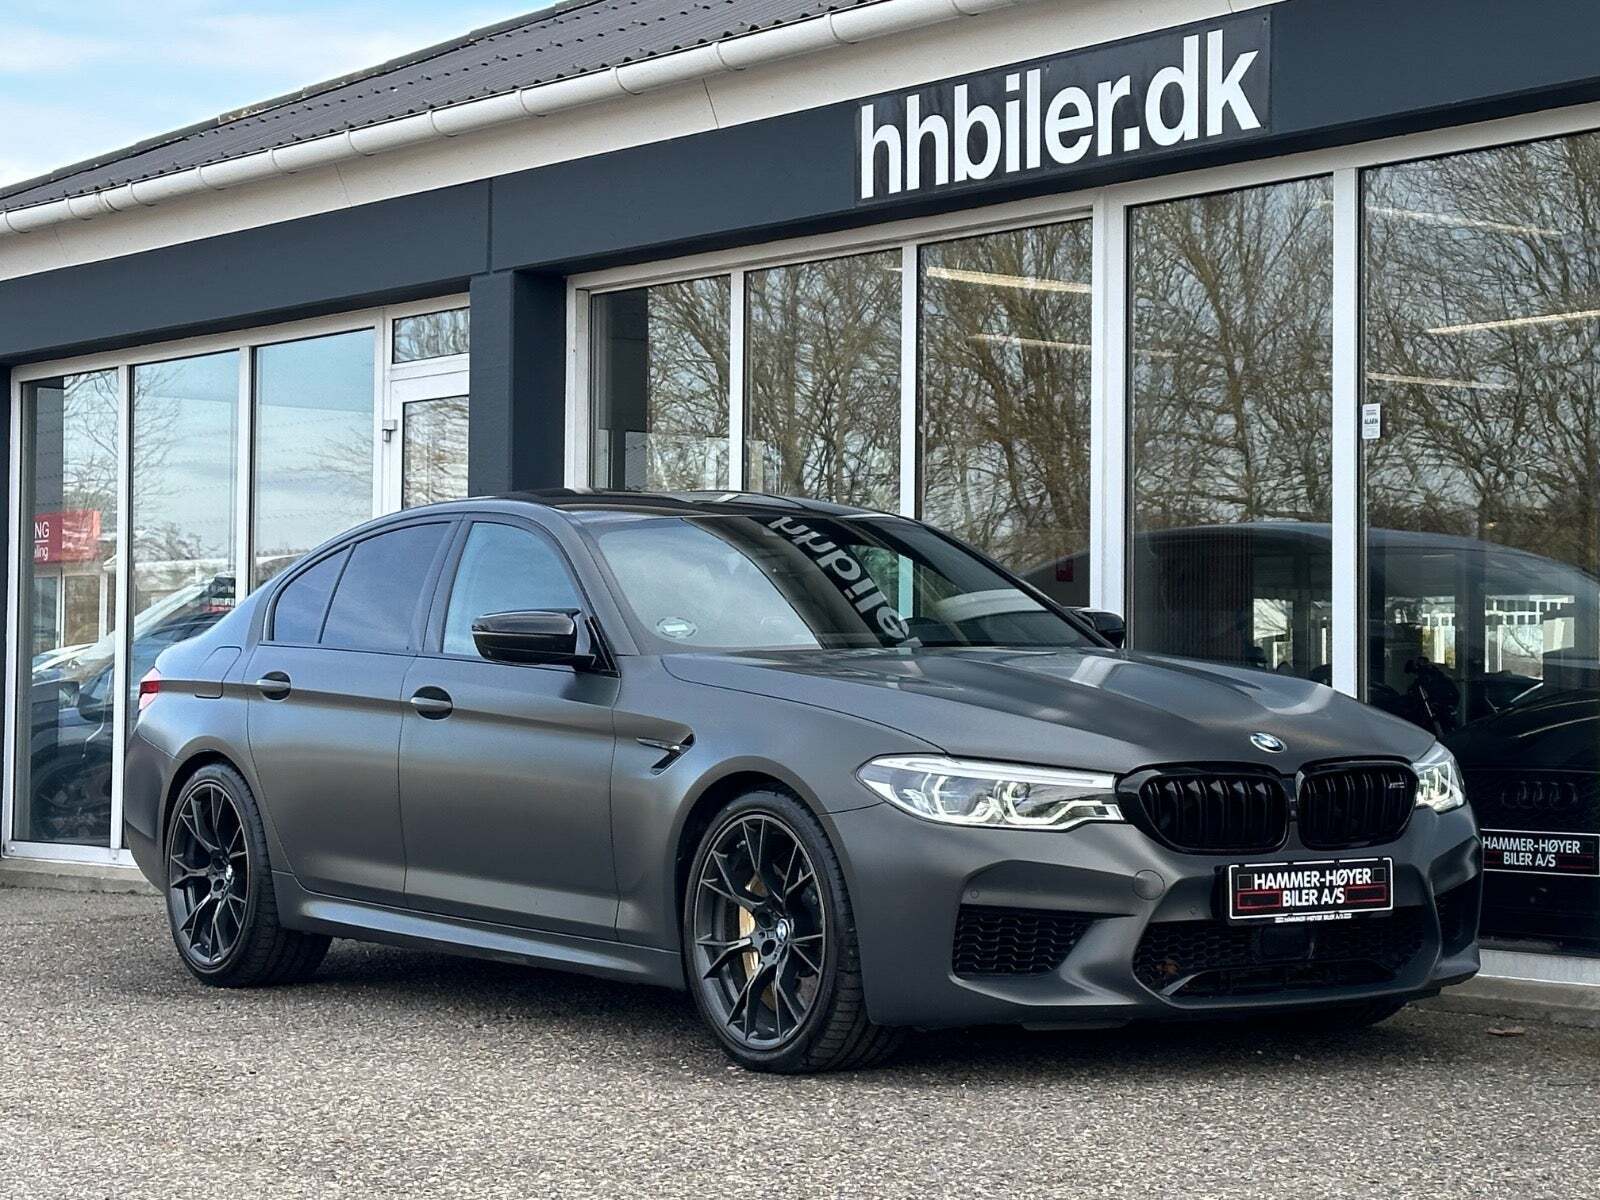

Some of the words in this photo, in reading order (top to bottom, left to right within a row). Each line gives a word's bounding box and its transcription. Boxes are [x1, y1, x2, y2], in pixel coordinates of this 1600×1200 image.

[861, 29, 1262, 199] hhbiler.dk
[1482, 835, 1581, 854] HAMMER-HØYER
[1503, 851, 1533, 866] BILER
[1535, 853, 1556, 867] A/S
[1253, 868, 1372, 891] HAMMER-HØYER
[1282, 889, 1318, 907] BILER
[1320, 887, 1345, 905] A/S
